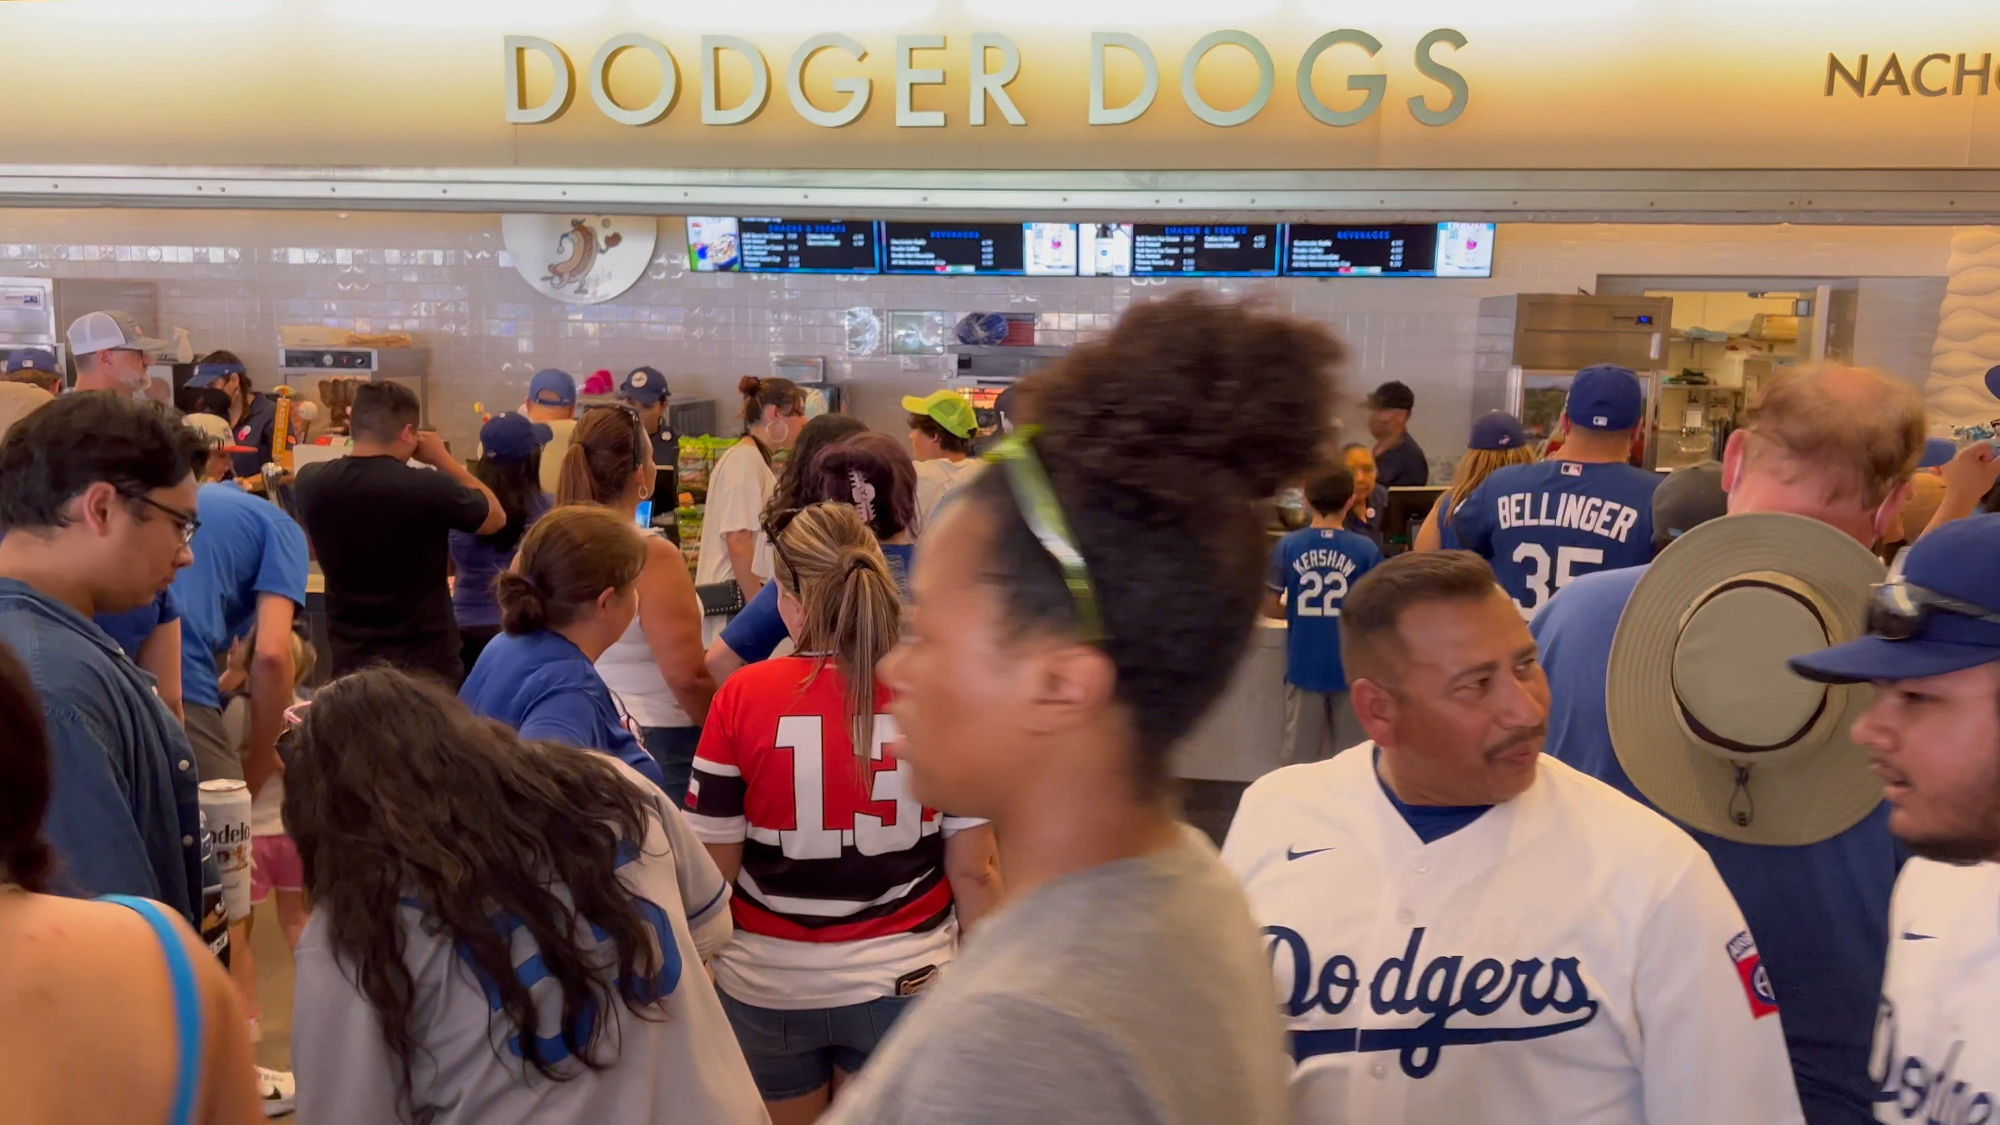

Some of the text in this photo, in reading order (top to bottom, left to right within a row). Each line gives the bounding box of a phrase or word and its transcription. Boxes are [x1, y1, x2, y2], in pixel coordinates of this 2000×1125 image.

[503, 28, 1469, 127] DODGER DOGS
[1824, 52, 2000, 97] NACH
[930, 230, 980, 239] BEVERAGES
[1336, 231, 1390, 240] BEVERAGES
[1498, 492, 1638, 543] BELLINGER
[1293, 549, 1356, 577] KERSHAW
[1298, 571, 1348, 616] 22
[775, 714, 923, 860] 13
[1262, 925, 1598, 1079] Dodgers
